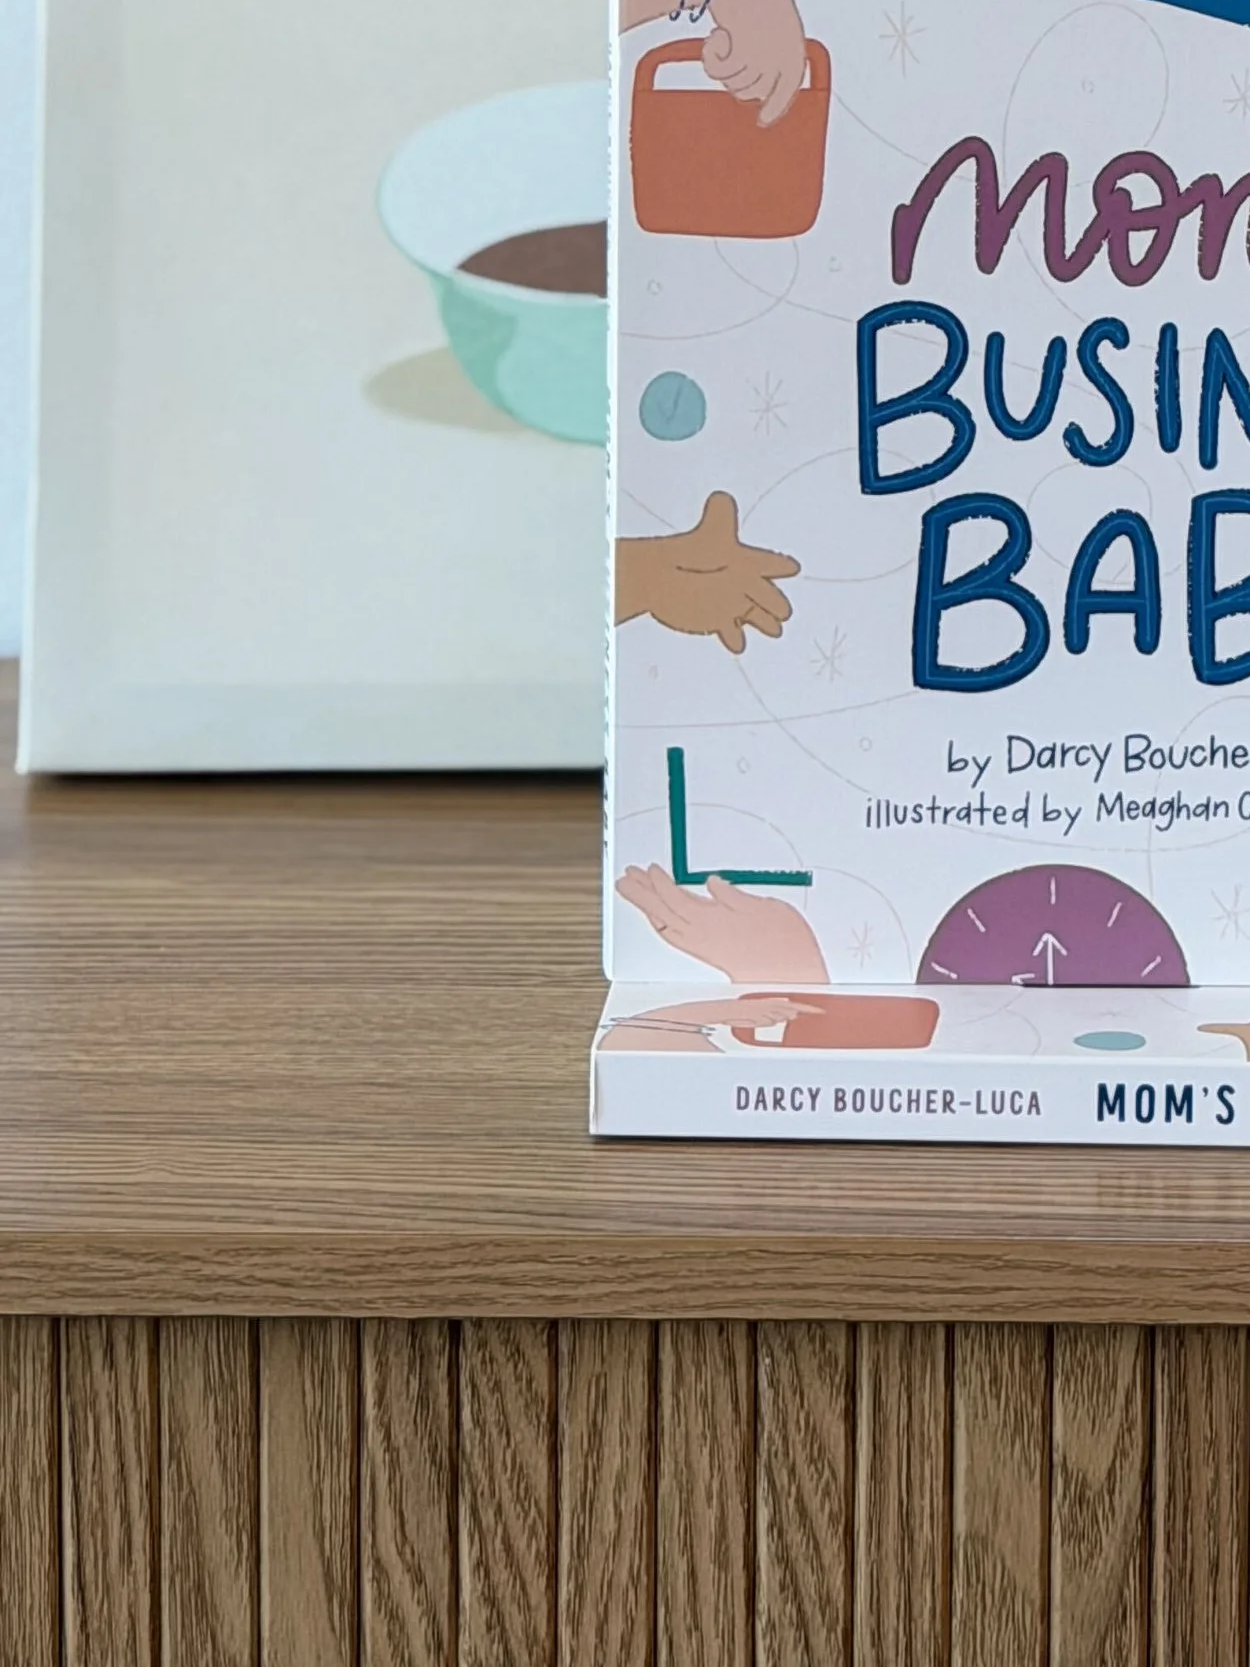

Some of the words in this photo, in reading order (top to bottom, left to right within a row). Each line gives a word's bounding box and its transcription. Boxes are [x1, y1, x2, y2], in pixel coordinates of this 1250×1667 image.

[947, 740, 992, 789] by
[1006, 734, 1112, 783] Darcy
[866, 791, 1030, 829] illustrated
[1042, 793, 1082, 836] by
[1096, 790, 1230, 832] Meaghan
[735, 1085, 822, 1113] DARCY
[832, 1087, 1042, 1117] BOUCHER-LUCA
[1096, 1082, 1236, 1126] MOM'S
